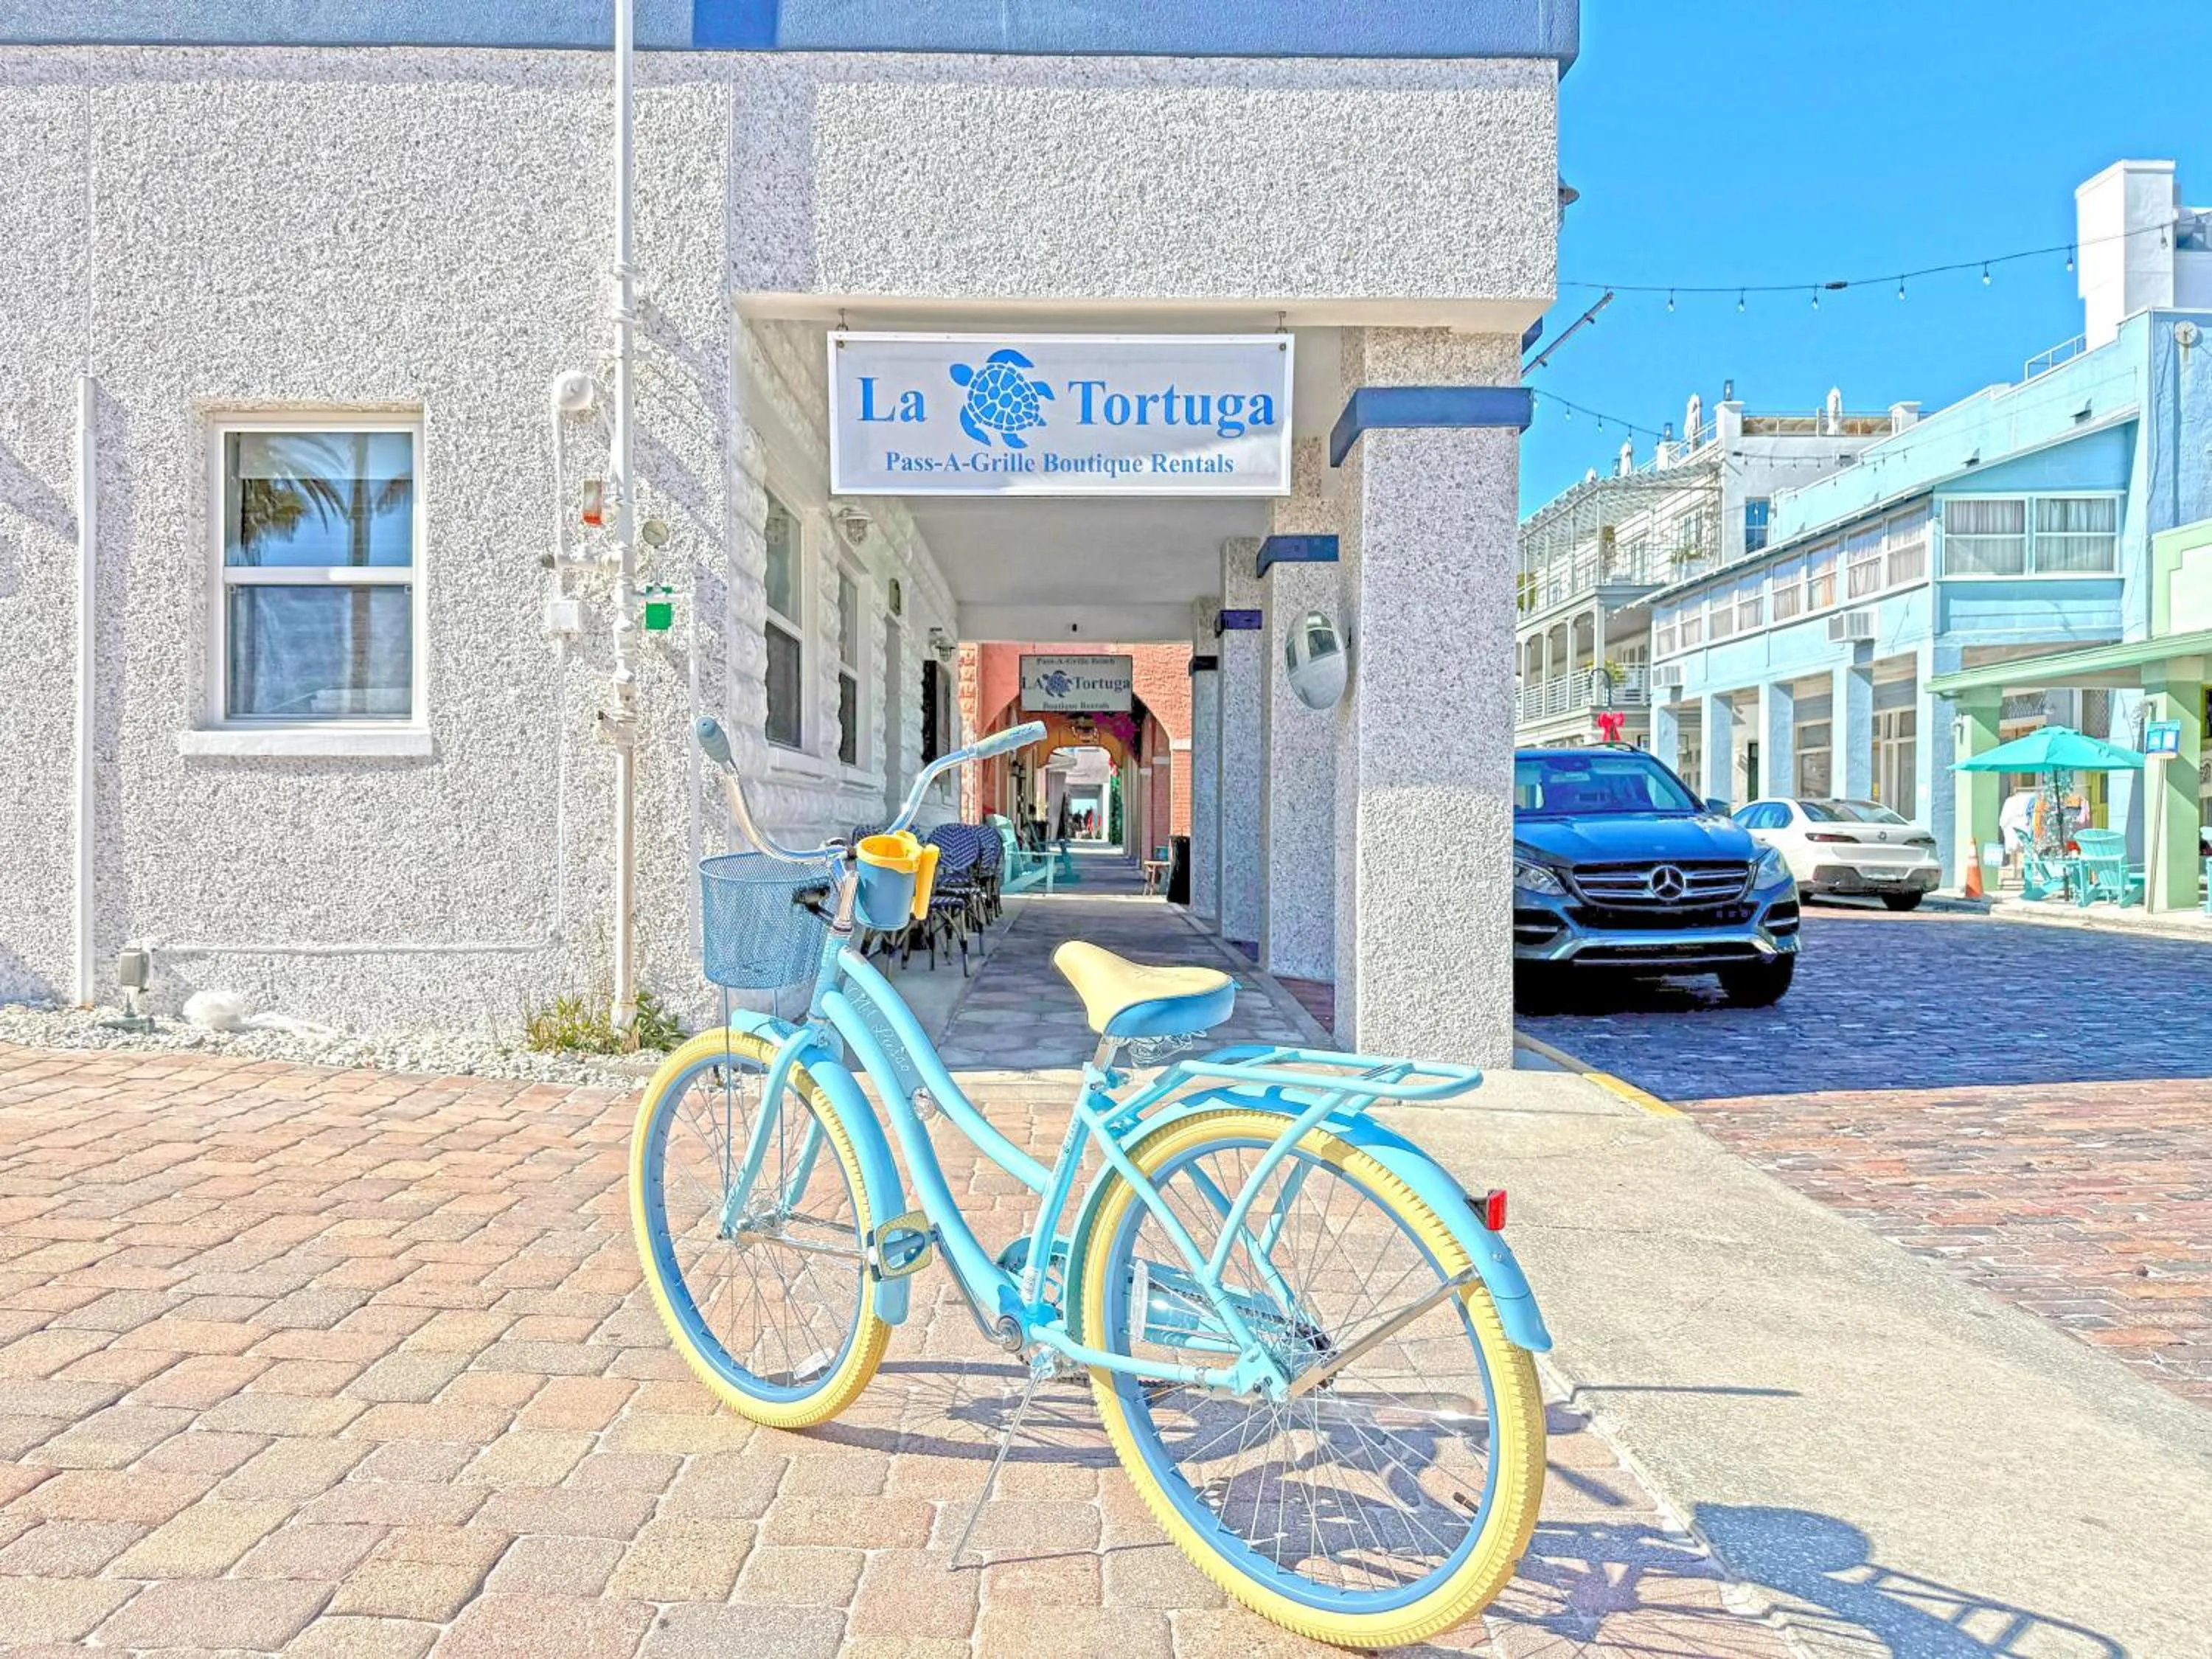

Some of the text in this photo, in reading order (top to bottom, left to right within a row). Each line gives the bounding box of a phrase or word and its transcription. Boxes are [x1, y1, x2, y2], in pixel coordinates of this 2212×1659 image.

[856, 377, 1275, 438] La Tortuga
[886, 452, 1234, 478] Pass-A-Grille Boutique Rentals
[1074, 676, 1130, 692] Tortuga
